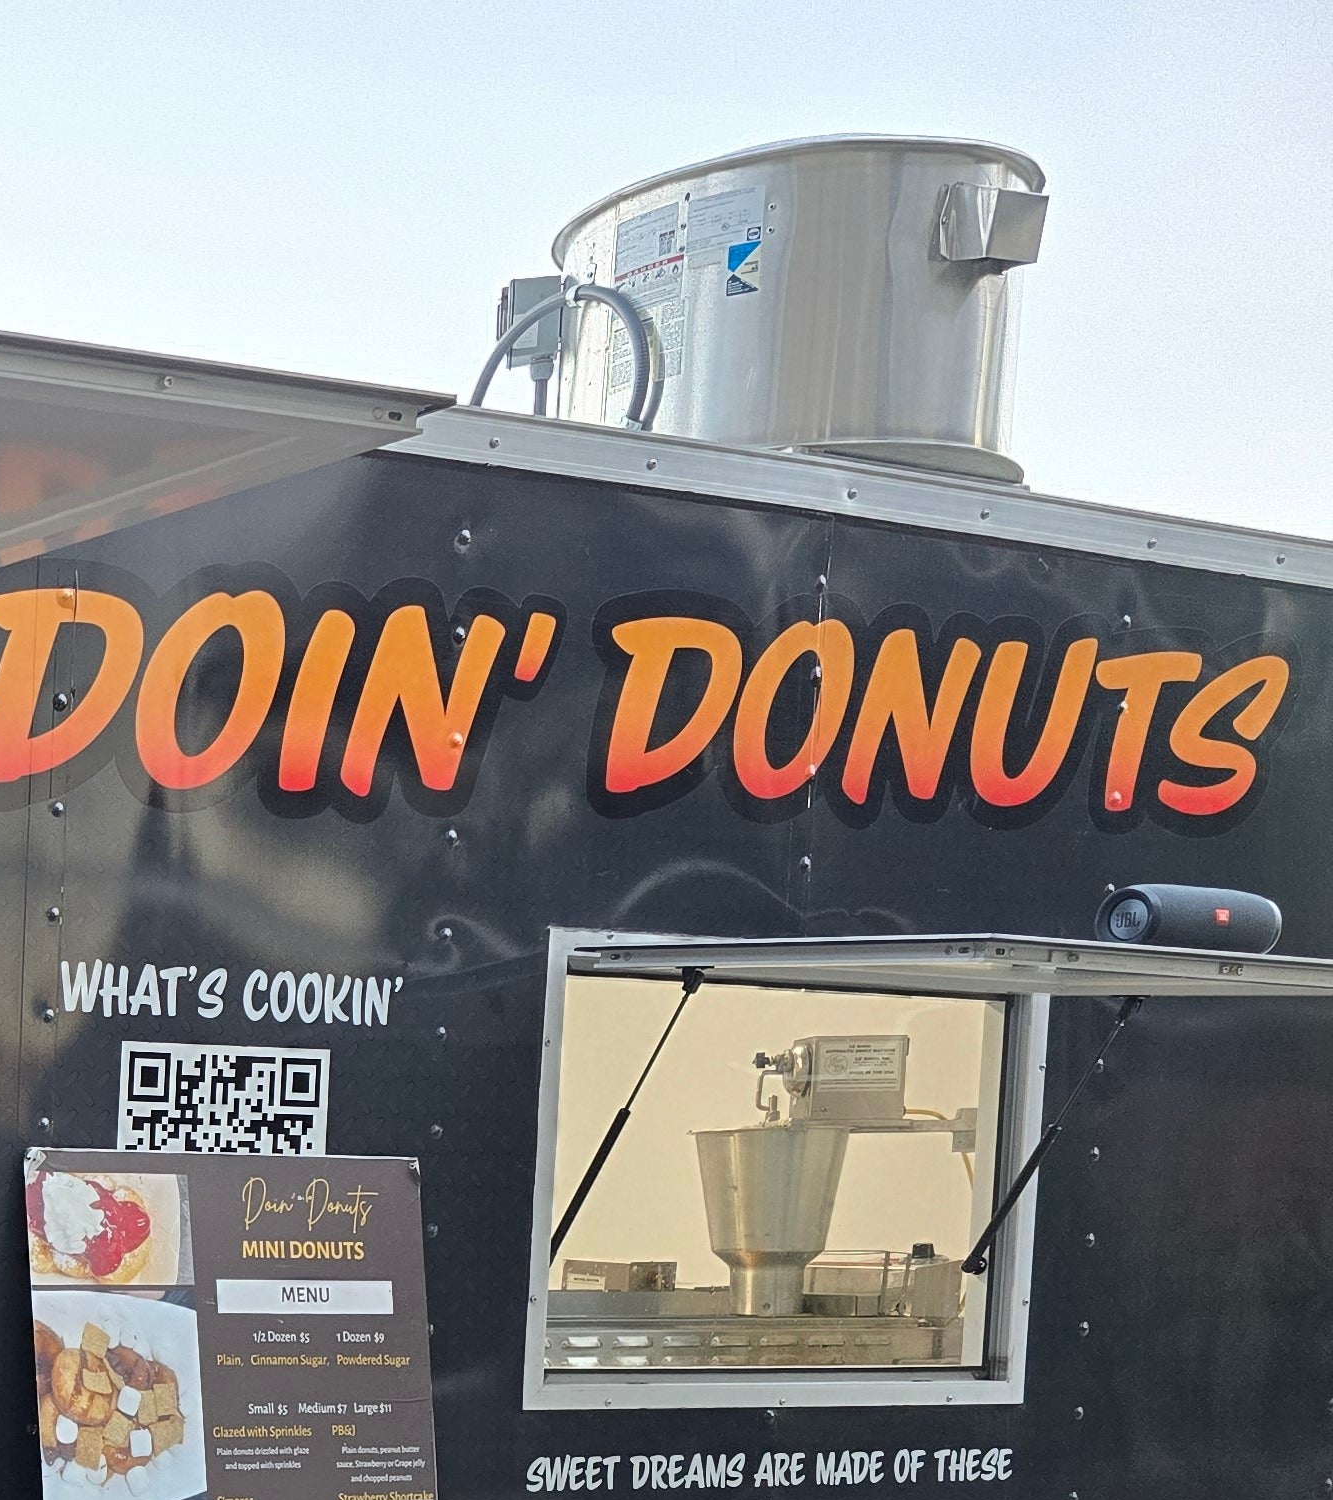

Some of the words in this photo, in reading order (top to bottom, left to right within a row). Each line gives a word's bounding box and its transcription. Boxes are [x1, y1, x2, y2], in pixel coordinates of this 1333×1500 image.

[602, 616, 1289, 814] DONUTS
[1115, 911, 1141, 929] JBL
[60, 959, 228, 1019] WHAT'S
[242, 968, 404, 1027] COOKIN'
[242, 1177, 295, 1231] Doin'
[305, 1178, 379, 1234] Donuts
[242, 1240, 285, 1259] MINI
[290, 1241, 365, 1260] DONUTS
[281, 1286, 330, 1303] MENU
[252, 1331, 267, 1344] 1/2
[268, 1331, 297, 1343] Dozen
[299, 1331, 310, 1344] $5
[336, 1332, 341, 1342] 1
[342, 1331, 371, 1343] Dozen
[374, 1331, 385, 1344] $9
[216, 1354, 244, 1367] Plain,
[250, 1354, 299, 1366] Cinnamon
[300, 1354, 330, 1368] Sugar,
[336, 1354, 383, 1366] Powdered
[383, 1354, 410, 1368] Sugar
[248, 1402, 274, 1414] Small
[277, 1403, 288, 1415] $5
[298, 1402, 336, 1414] Medium
[337, 1403, 347, 1414] $7
[354, 1402, 378, 1415] Large
[379, 1402, 392, 1414] $11
[213, 1425, 245, 1438] Glazed
[246, 1426, 268, 1437] with
[269, 1425, 312, 1439] Sprinkles
[332, 1425, 355, 1436] PB&J
[526, 1456, 621, 1493] SWEET
[630, 1453, 746, 1490] DREAMS
[753, 1451, 806, 1488] ARE
[814, 1450, 885, 1486] MADE
[893, 1448, 926, 1484] OF
[934, 1447, 1013, 1482] THESE
